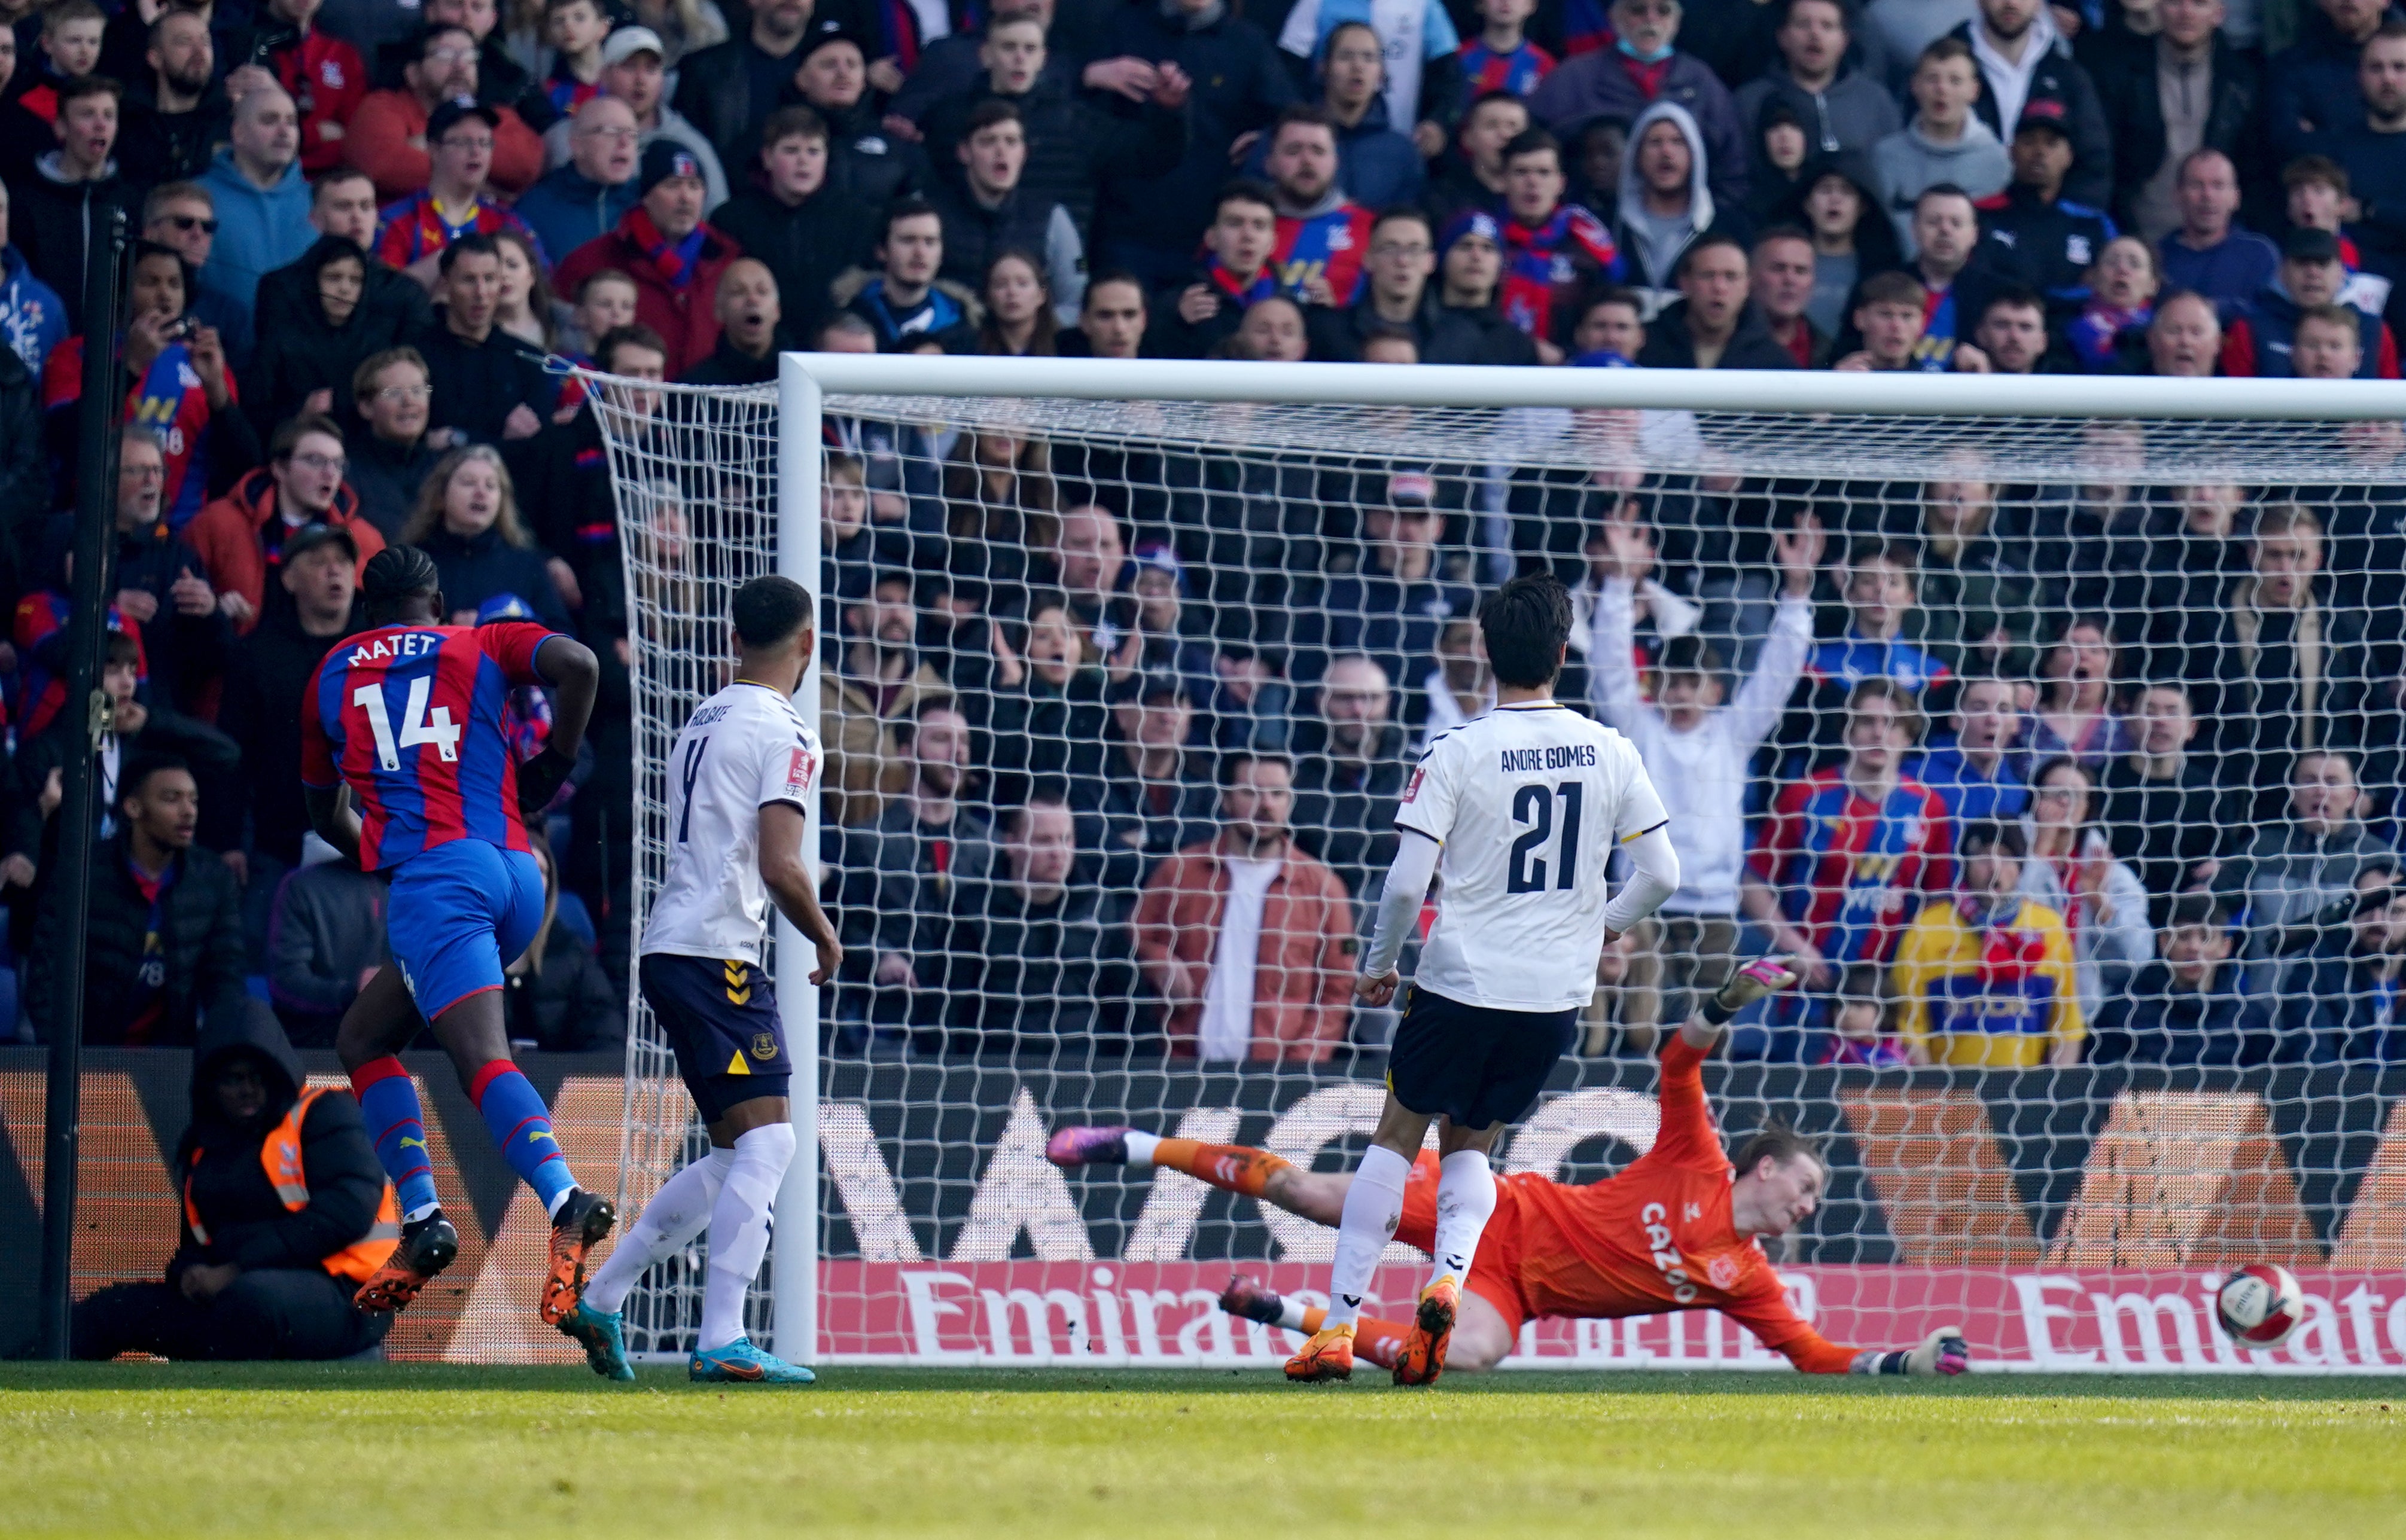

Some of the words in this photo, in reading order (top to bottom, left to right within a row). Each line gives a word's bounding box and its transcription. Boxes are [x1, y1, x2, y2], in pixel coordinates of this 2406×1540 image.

[354, 675, 461, 771] 14
[690, 705, 732, 727] HOLGATE
[1546, 745, 1595, 769] GOMES
[678, 736, 709, 842] 4
[1507, 782, 1582, 893] 21
[1641, 1201, 1698, 1303] CAZOO
[2011, 1273, 2406, 1364] Emiat
